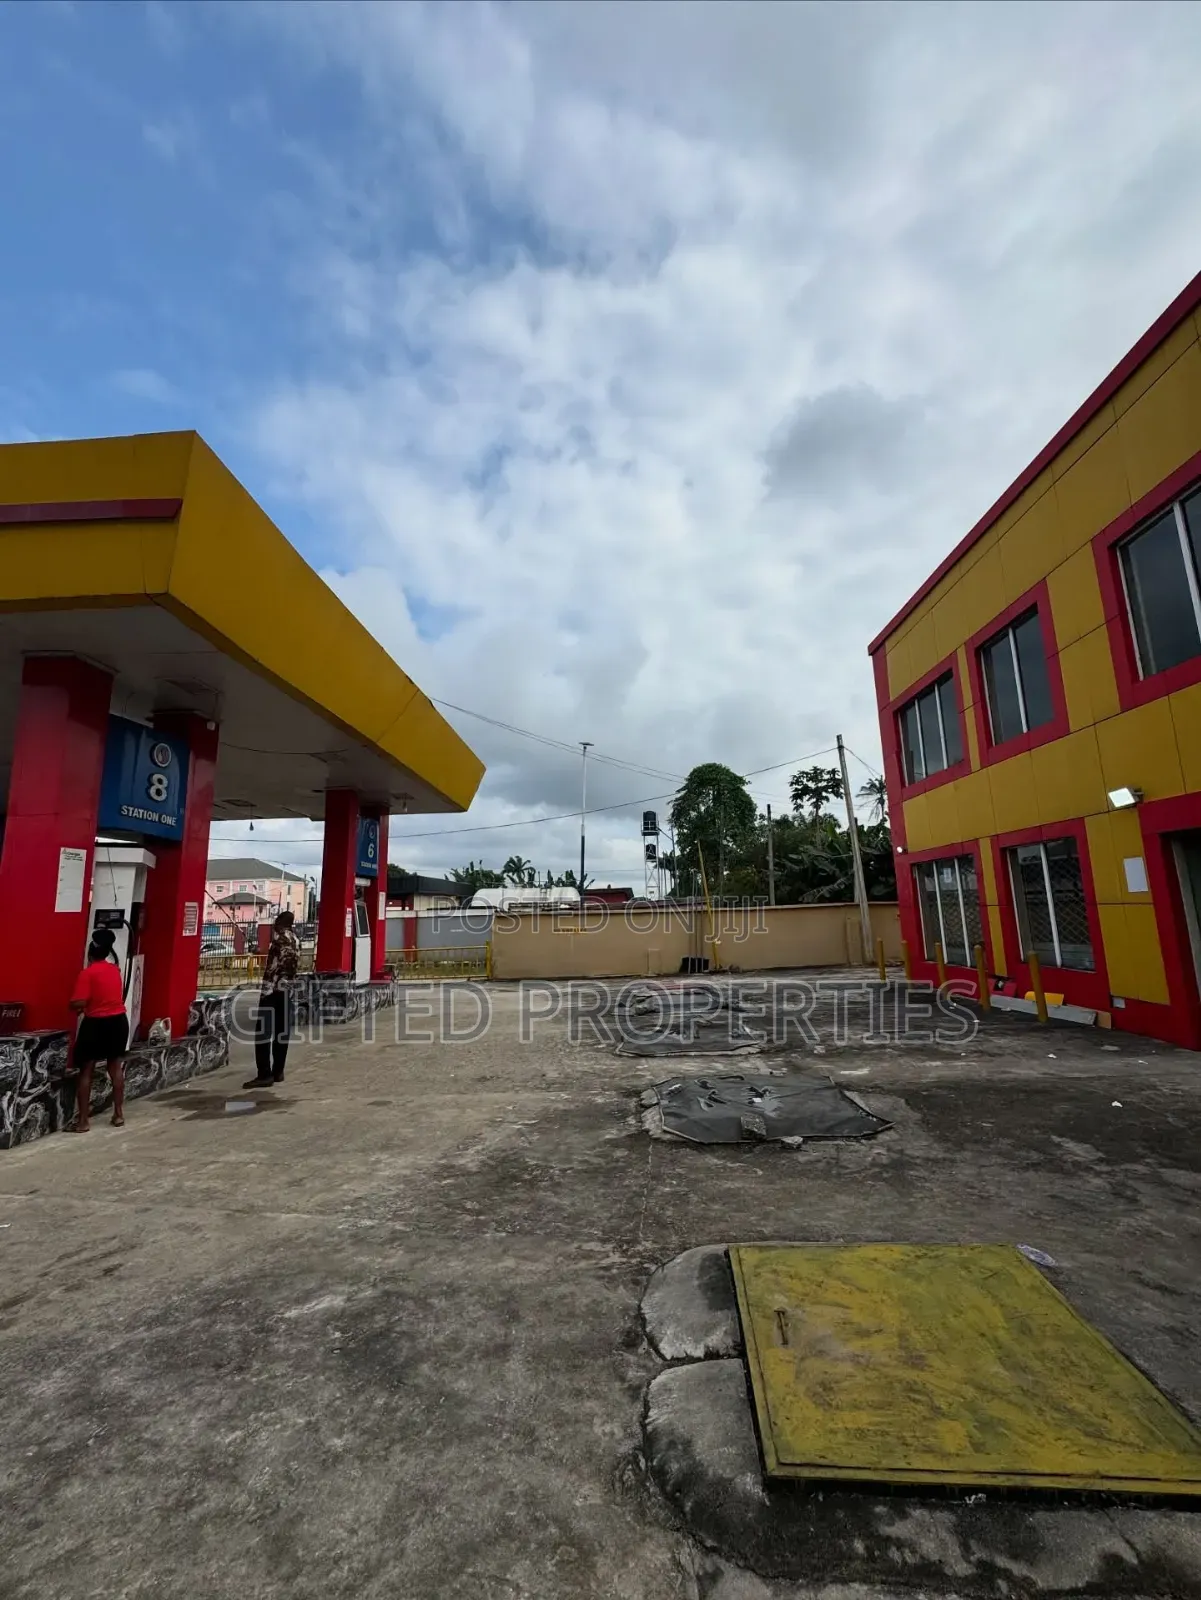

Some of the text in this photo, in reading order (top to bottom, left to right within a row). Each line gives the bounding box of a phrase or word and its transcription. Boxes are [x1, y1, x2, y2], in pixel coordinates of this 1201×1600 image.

[149, 773, 168, 801] 8
[121, 805, 177, 826] STATION ONE
[368, 844, 375, 858] 6
